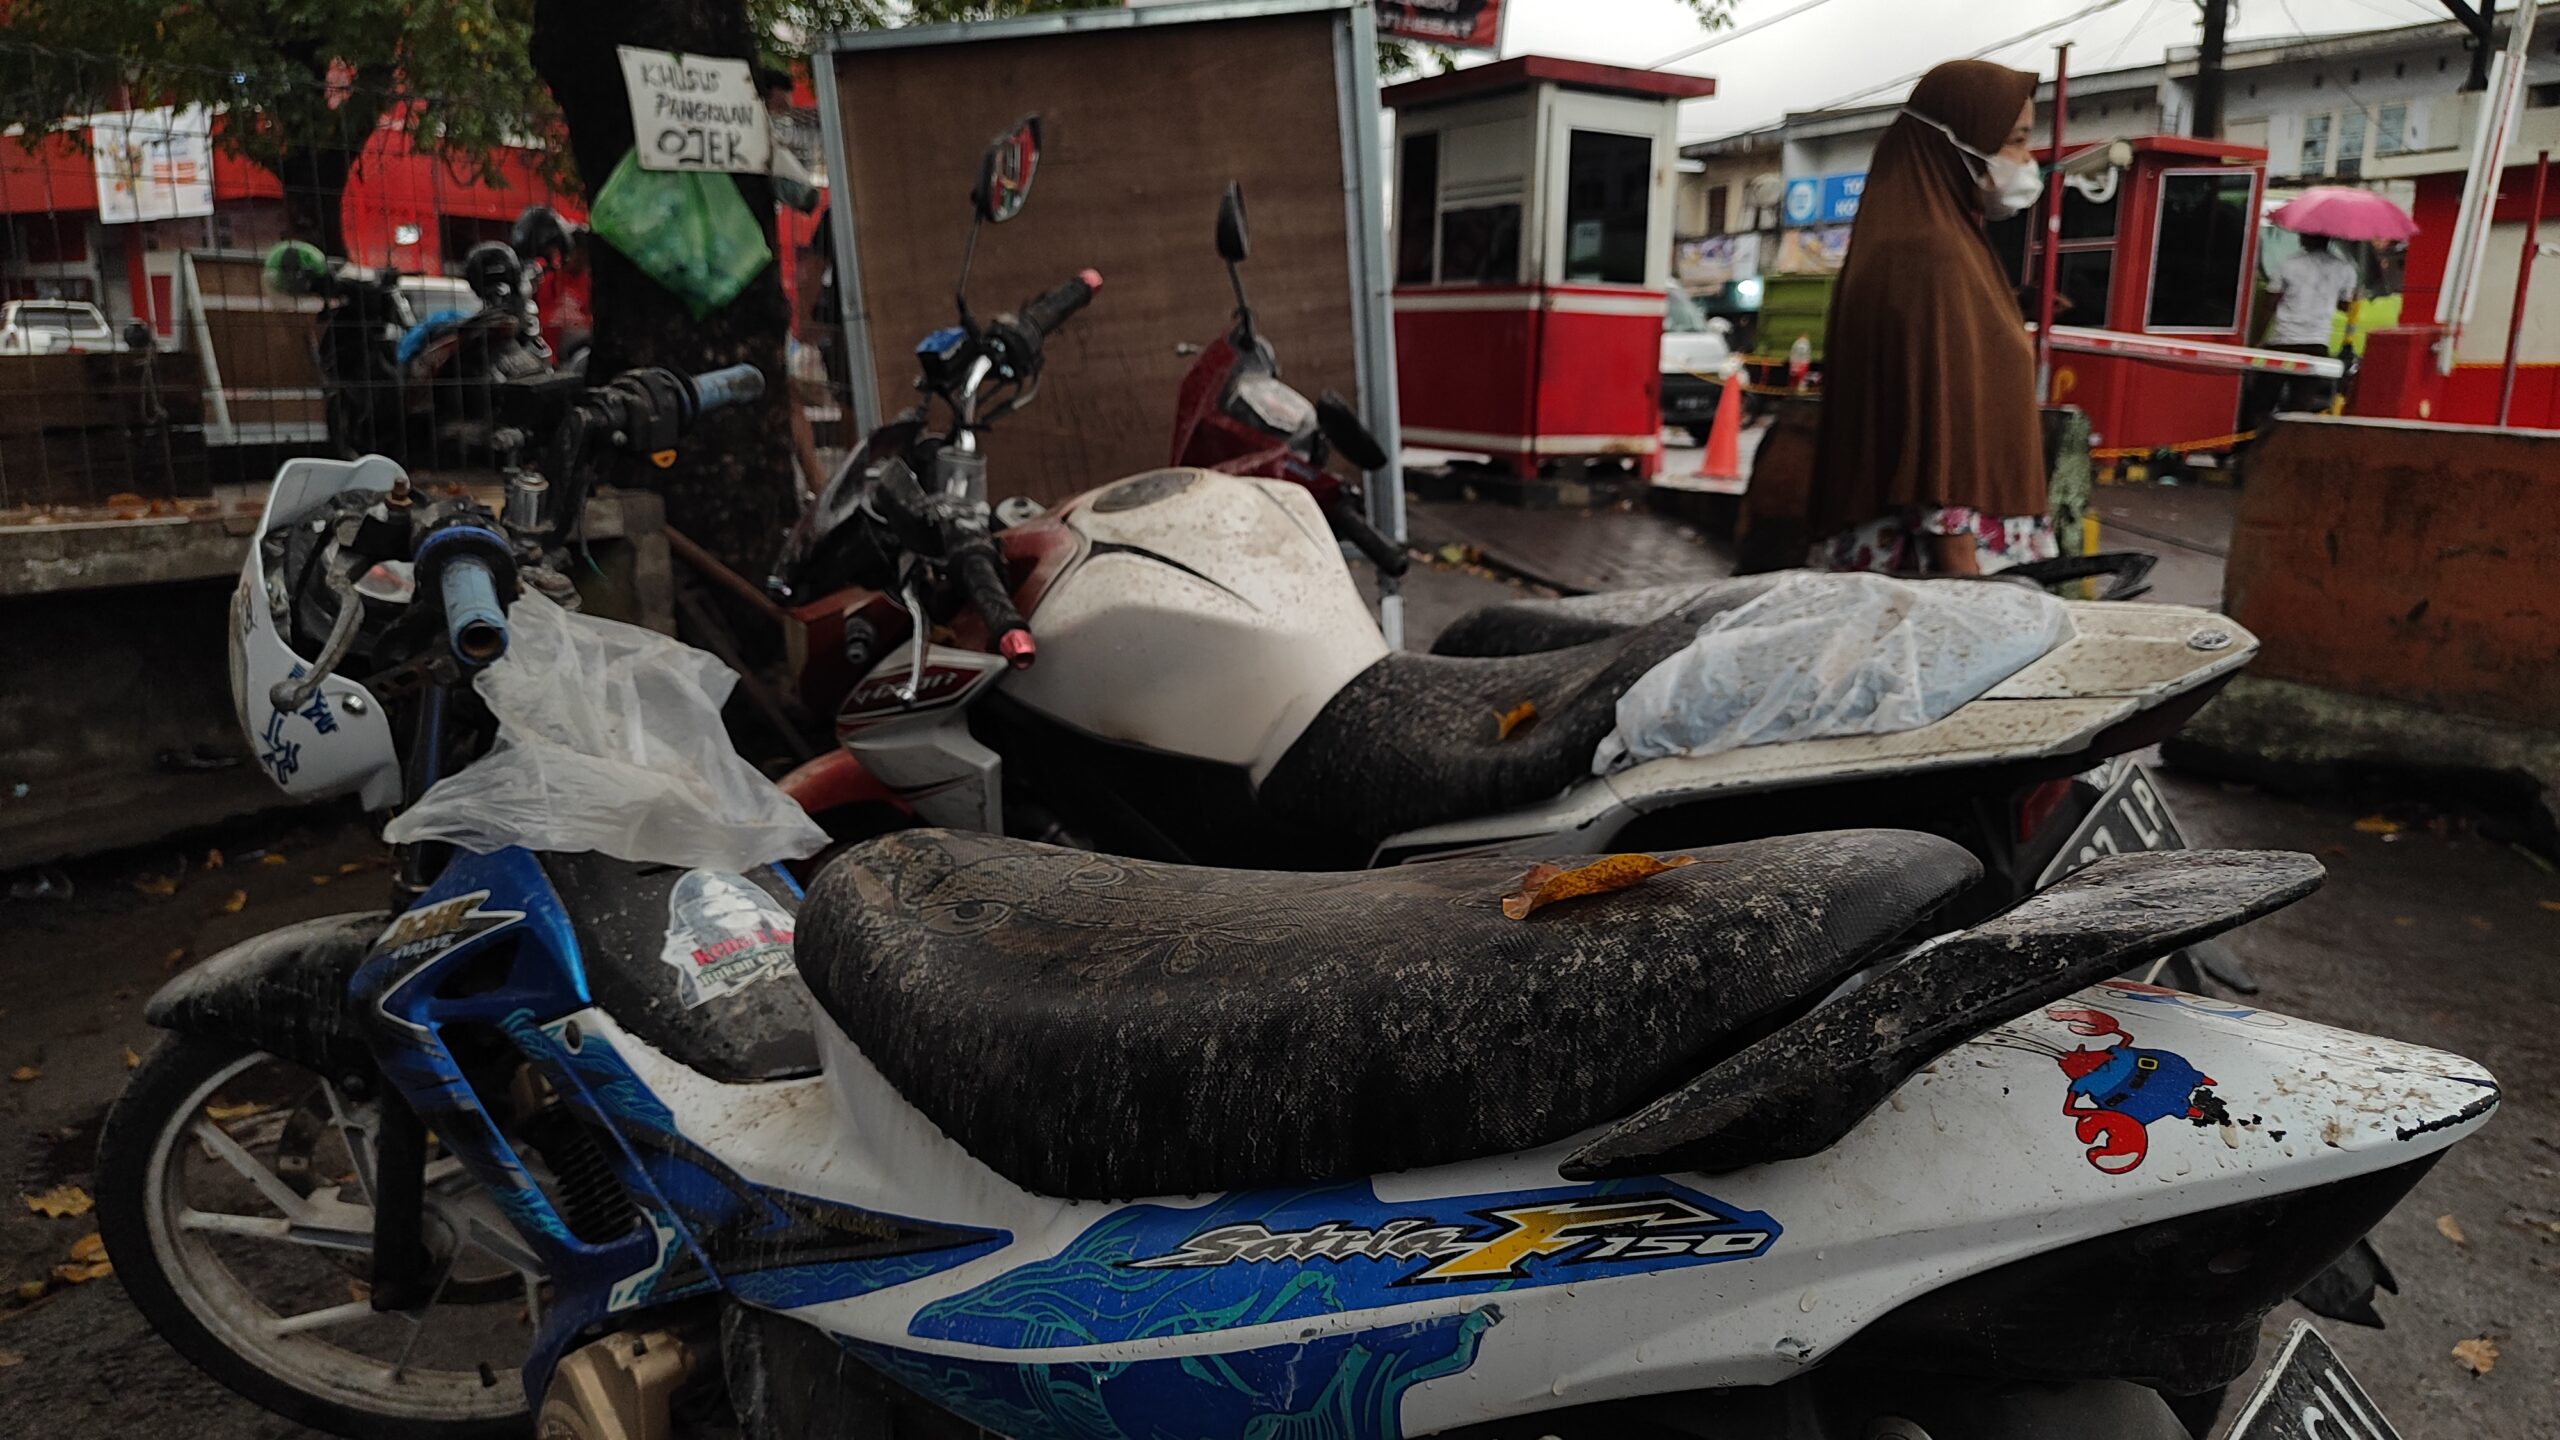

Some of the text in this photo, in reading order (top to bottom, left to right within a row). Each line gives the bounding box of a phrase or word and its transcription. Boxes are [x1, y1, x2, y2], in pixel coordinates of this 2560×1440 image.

[657, 127, 751, 167] OJEK
[2119, 778, 2163, 849] LP
[1121, 1219, 1474, 1270] Satria
